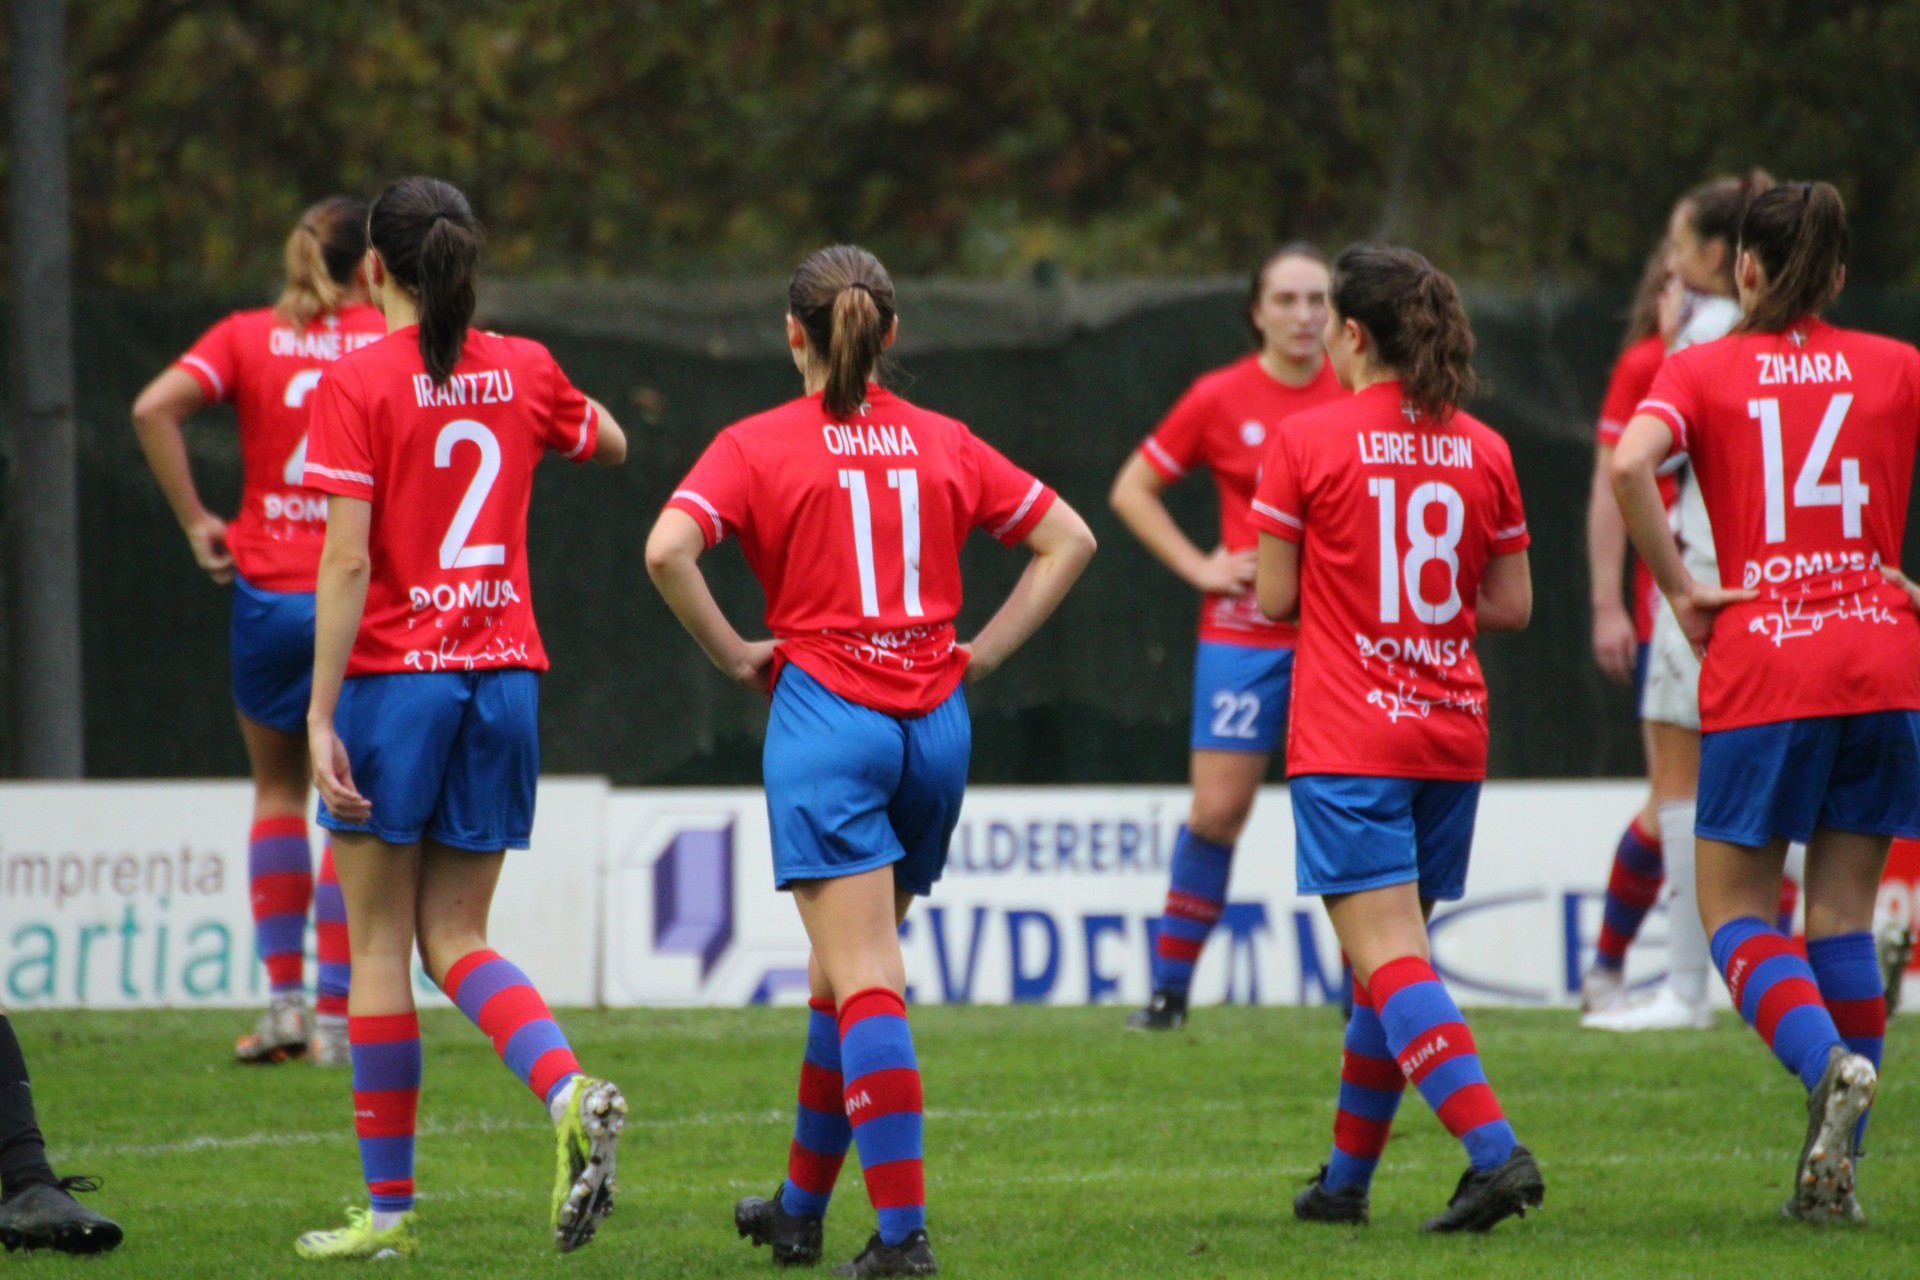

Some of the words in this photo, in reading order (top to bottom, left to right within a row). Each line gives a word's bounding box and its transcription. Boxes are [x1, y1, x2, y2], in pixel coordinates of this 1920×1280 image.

[412, 367, 514, 408] IRANTZU
[1756, 351, 1853, 385] ZIHARA
[821, 424, 919, 457] OIHANA
[1357, 431, 1417, 466] LEIRE
[1421, 434, 1473, 470] UCIN
[1747, 392, 1870, 544] 14
[433, 419, 506, 570] 2
[837, 468, 924, 618] 11
[1368, 477, 1465, 626] 18
[1210, 689, 1261, 739] 22
[0, 842, 224, 911] mprenta
